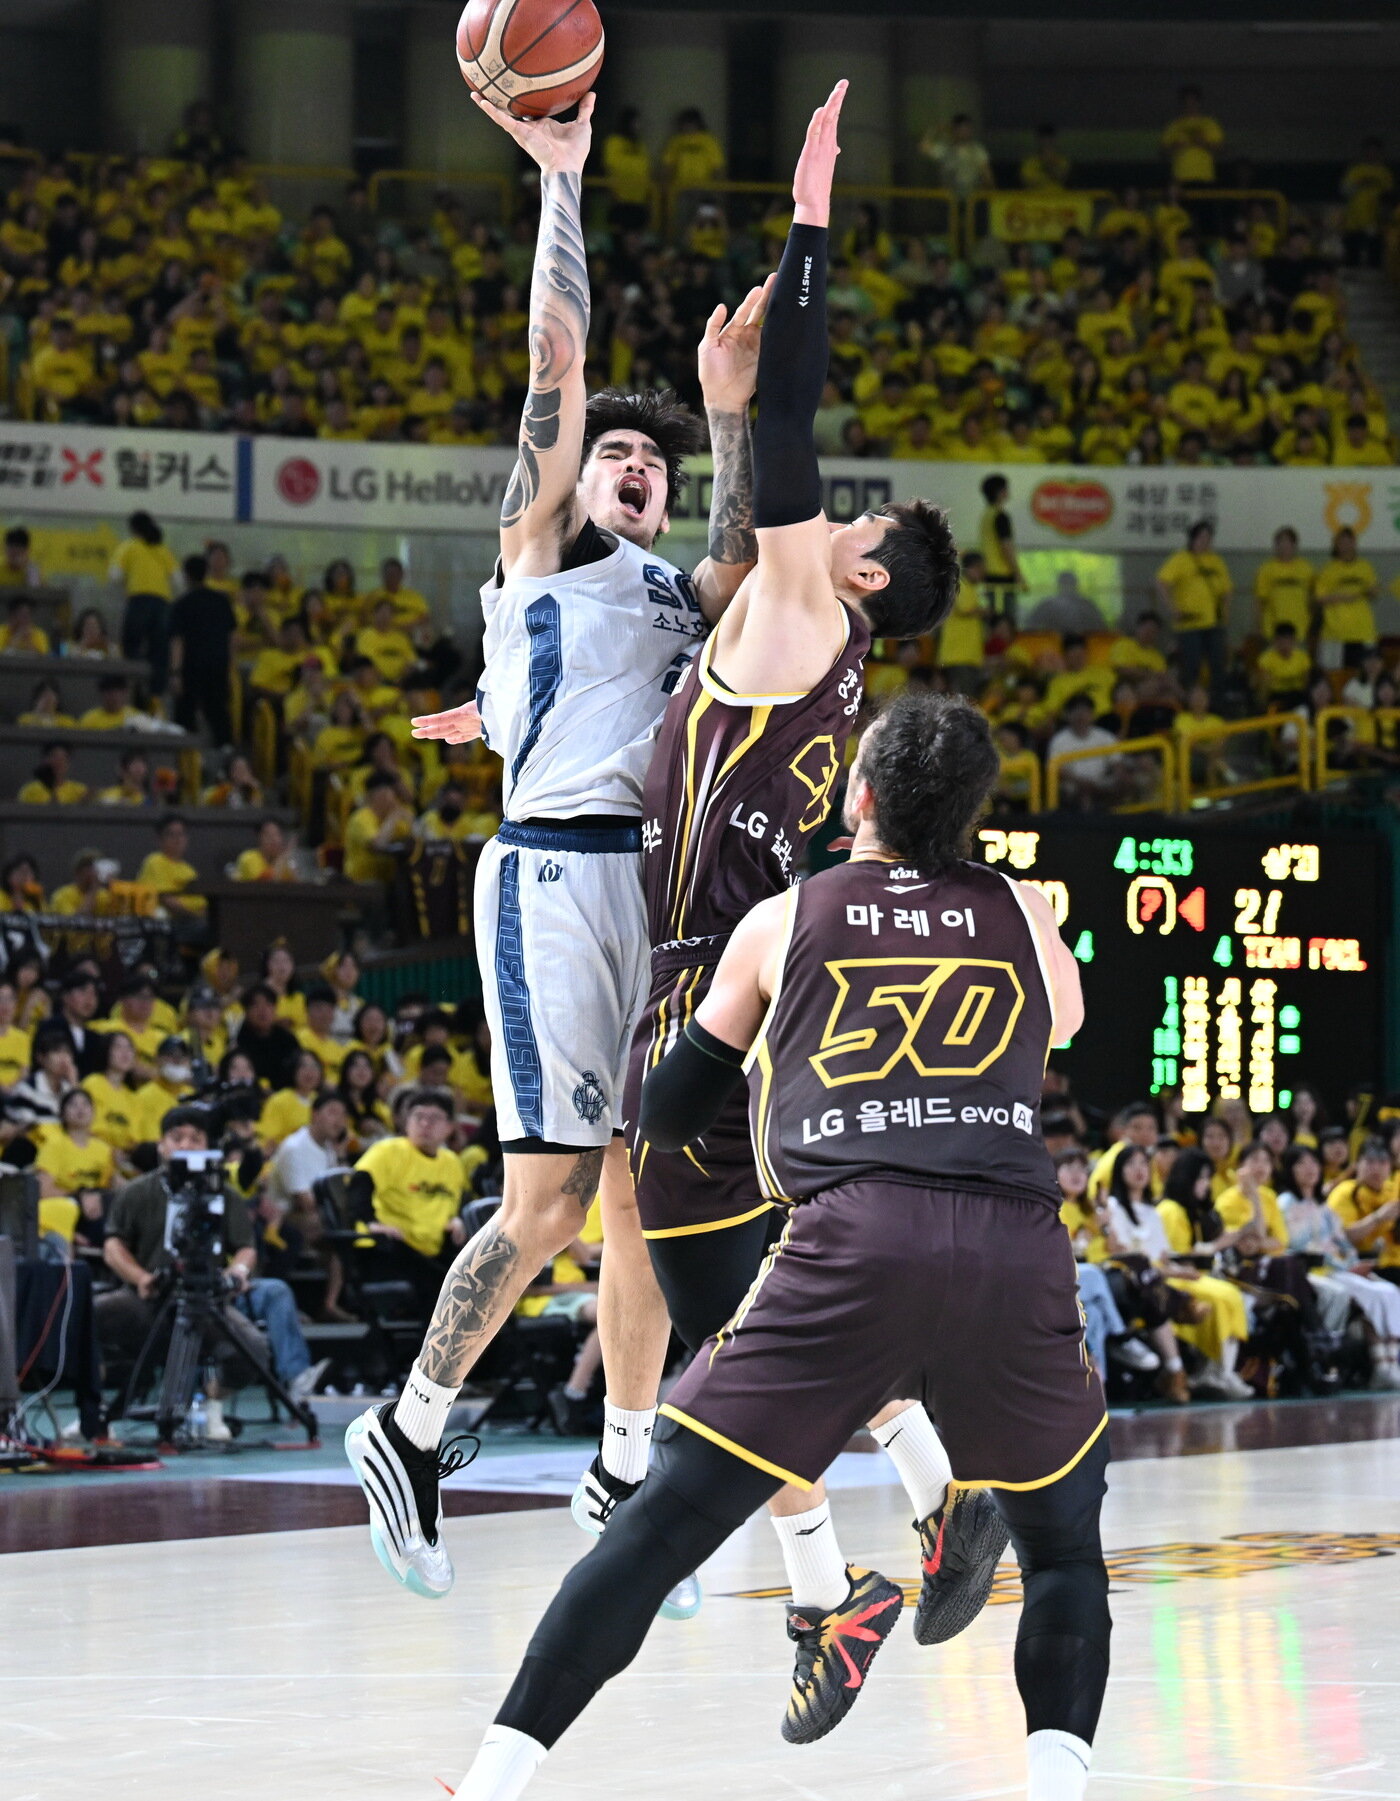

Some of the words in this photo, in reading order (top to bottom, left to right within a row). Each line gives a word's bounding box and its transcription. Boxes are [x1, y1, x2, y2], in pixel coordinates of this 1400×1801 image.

[328, 466, 378, 502] LG
[385, 469, 503, 506] HelloV
[729, 802, 769, 839] LG
[808, 957, 1026, 1089] 50
[802, 1108, 845, 1145] LG
[856, 1097, 956, 1133] 올레드
[961, 1106, 1009, 1126] evo
